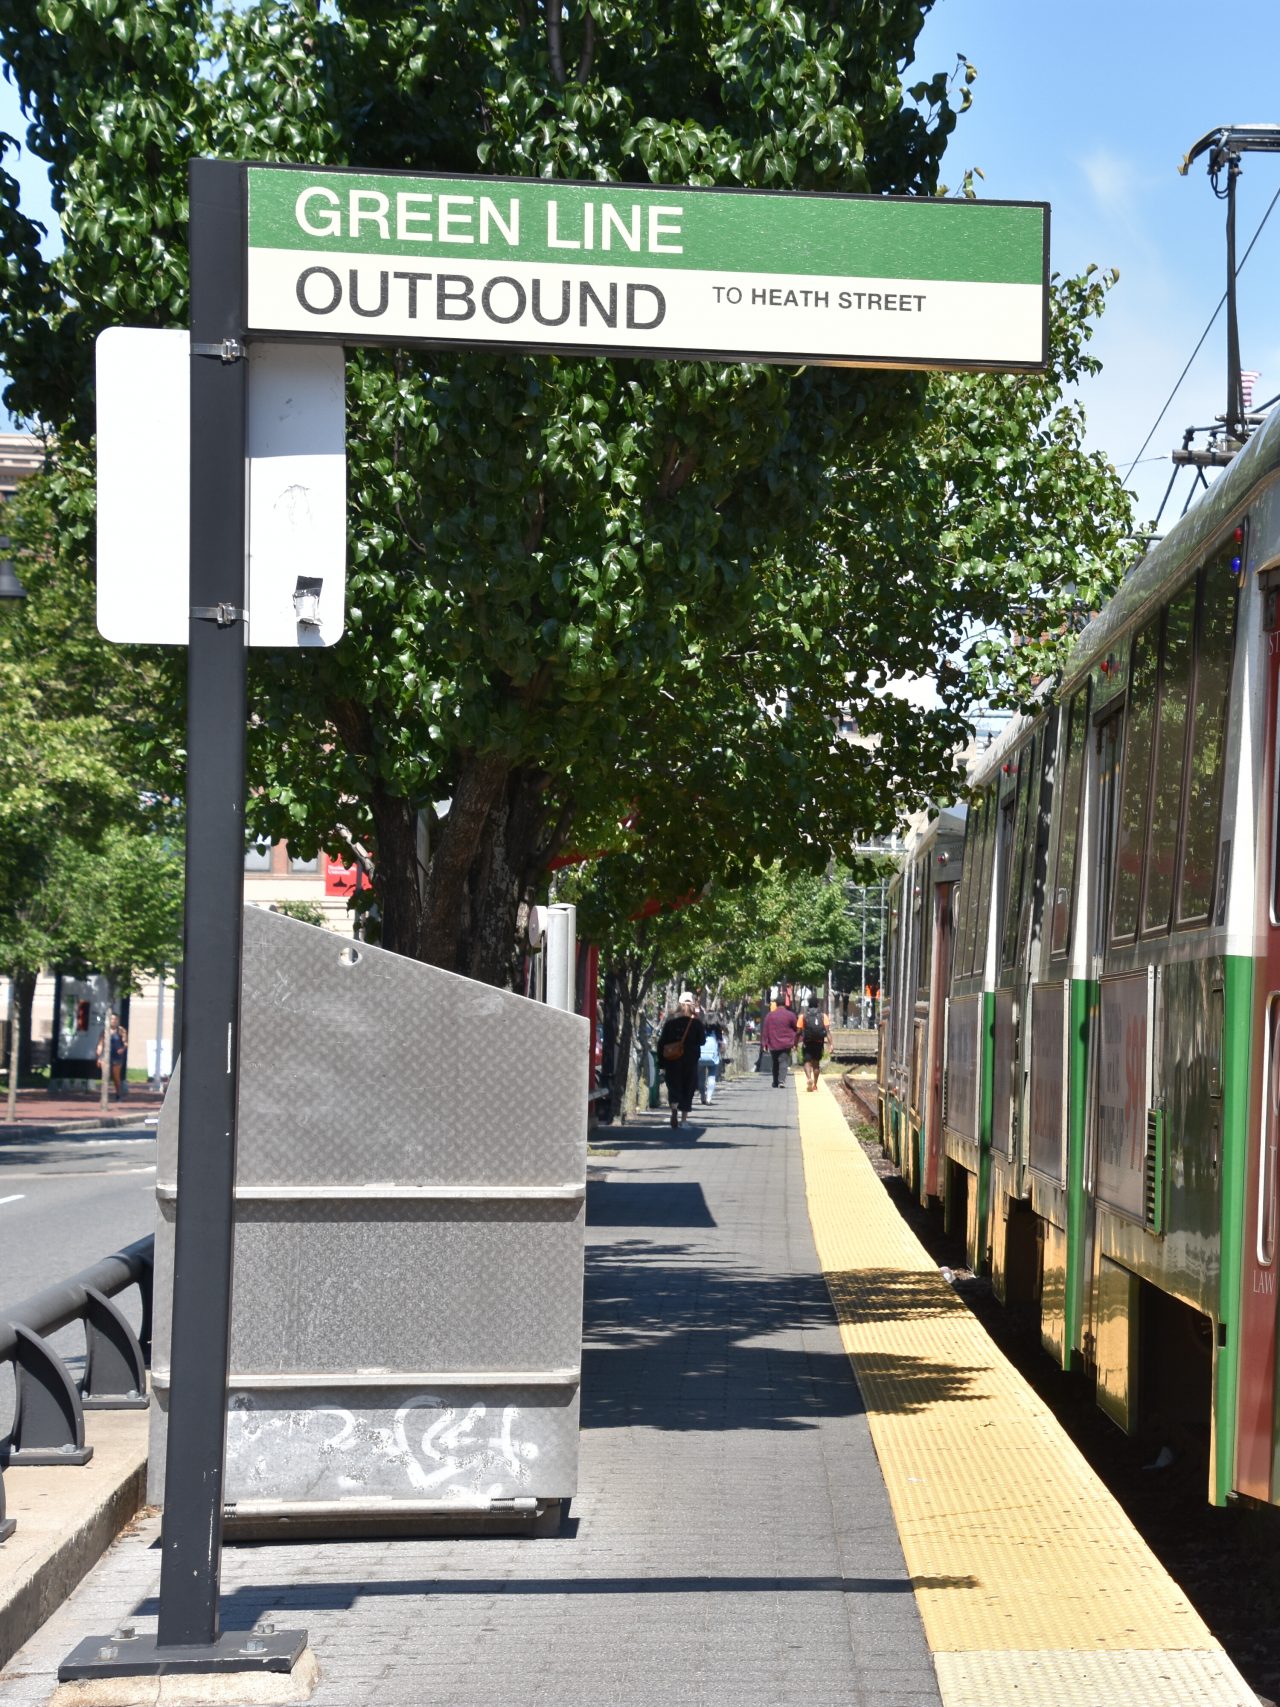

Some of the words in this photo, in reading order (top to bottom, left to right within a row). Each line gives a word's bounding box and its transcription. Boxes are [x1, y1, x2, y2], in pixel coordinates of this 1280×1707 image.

[295, 186, 520, 247] GREEN
[547, 200, 684, 255] LINE
[295, 266, 667, 331] OUTBOUND
[712, 286, 743, 305] TO
[751, 288, 829, 309] HEATH
[838, 292, 927, 312] STREET
[1253, 1270, 1276, 1296] LAW
